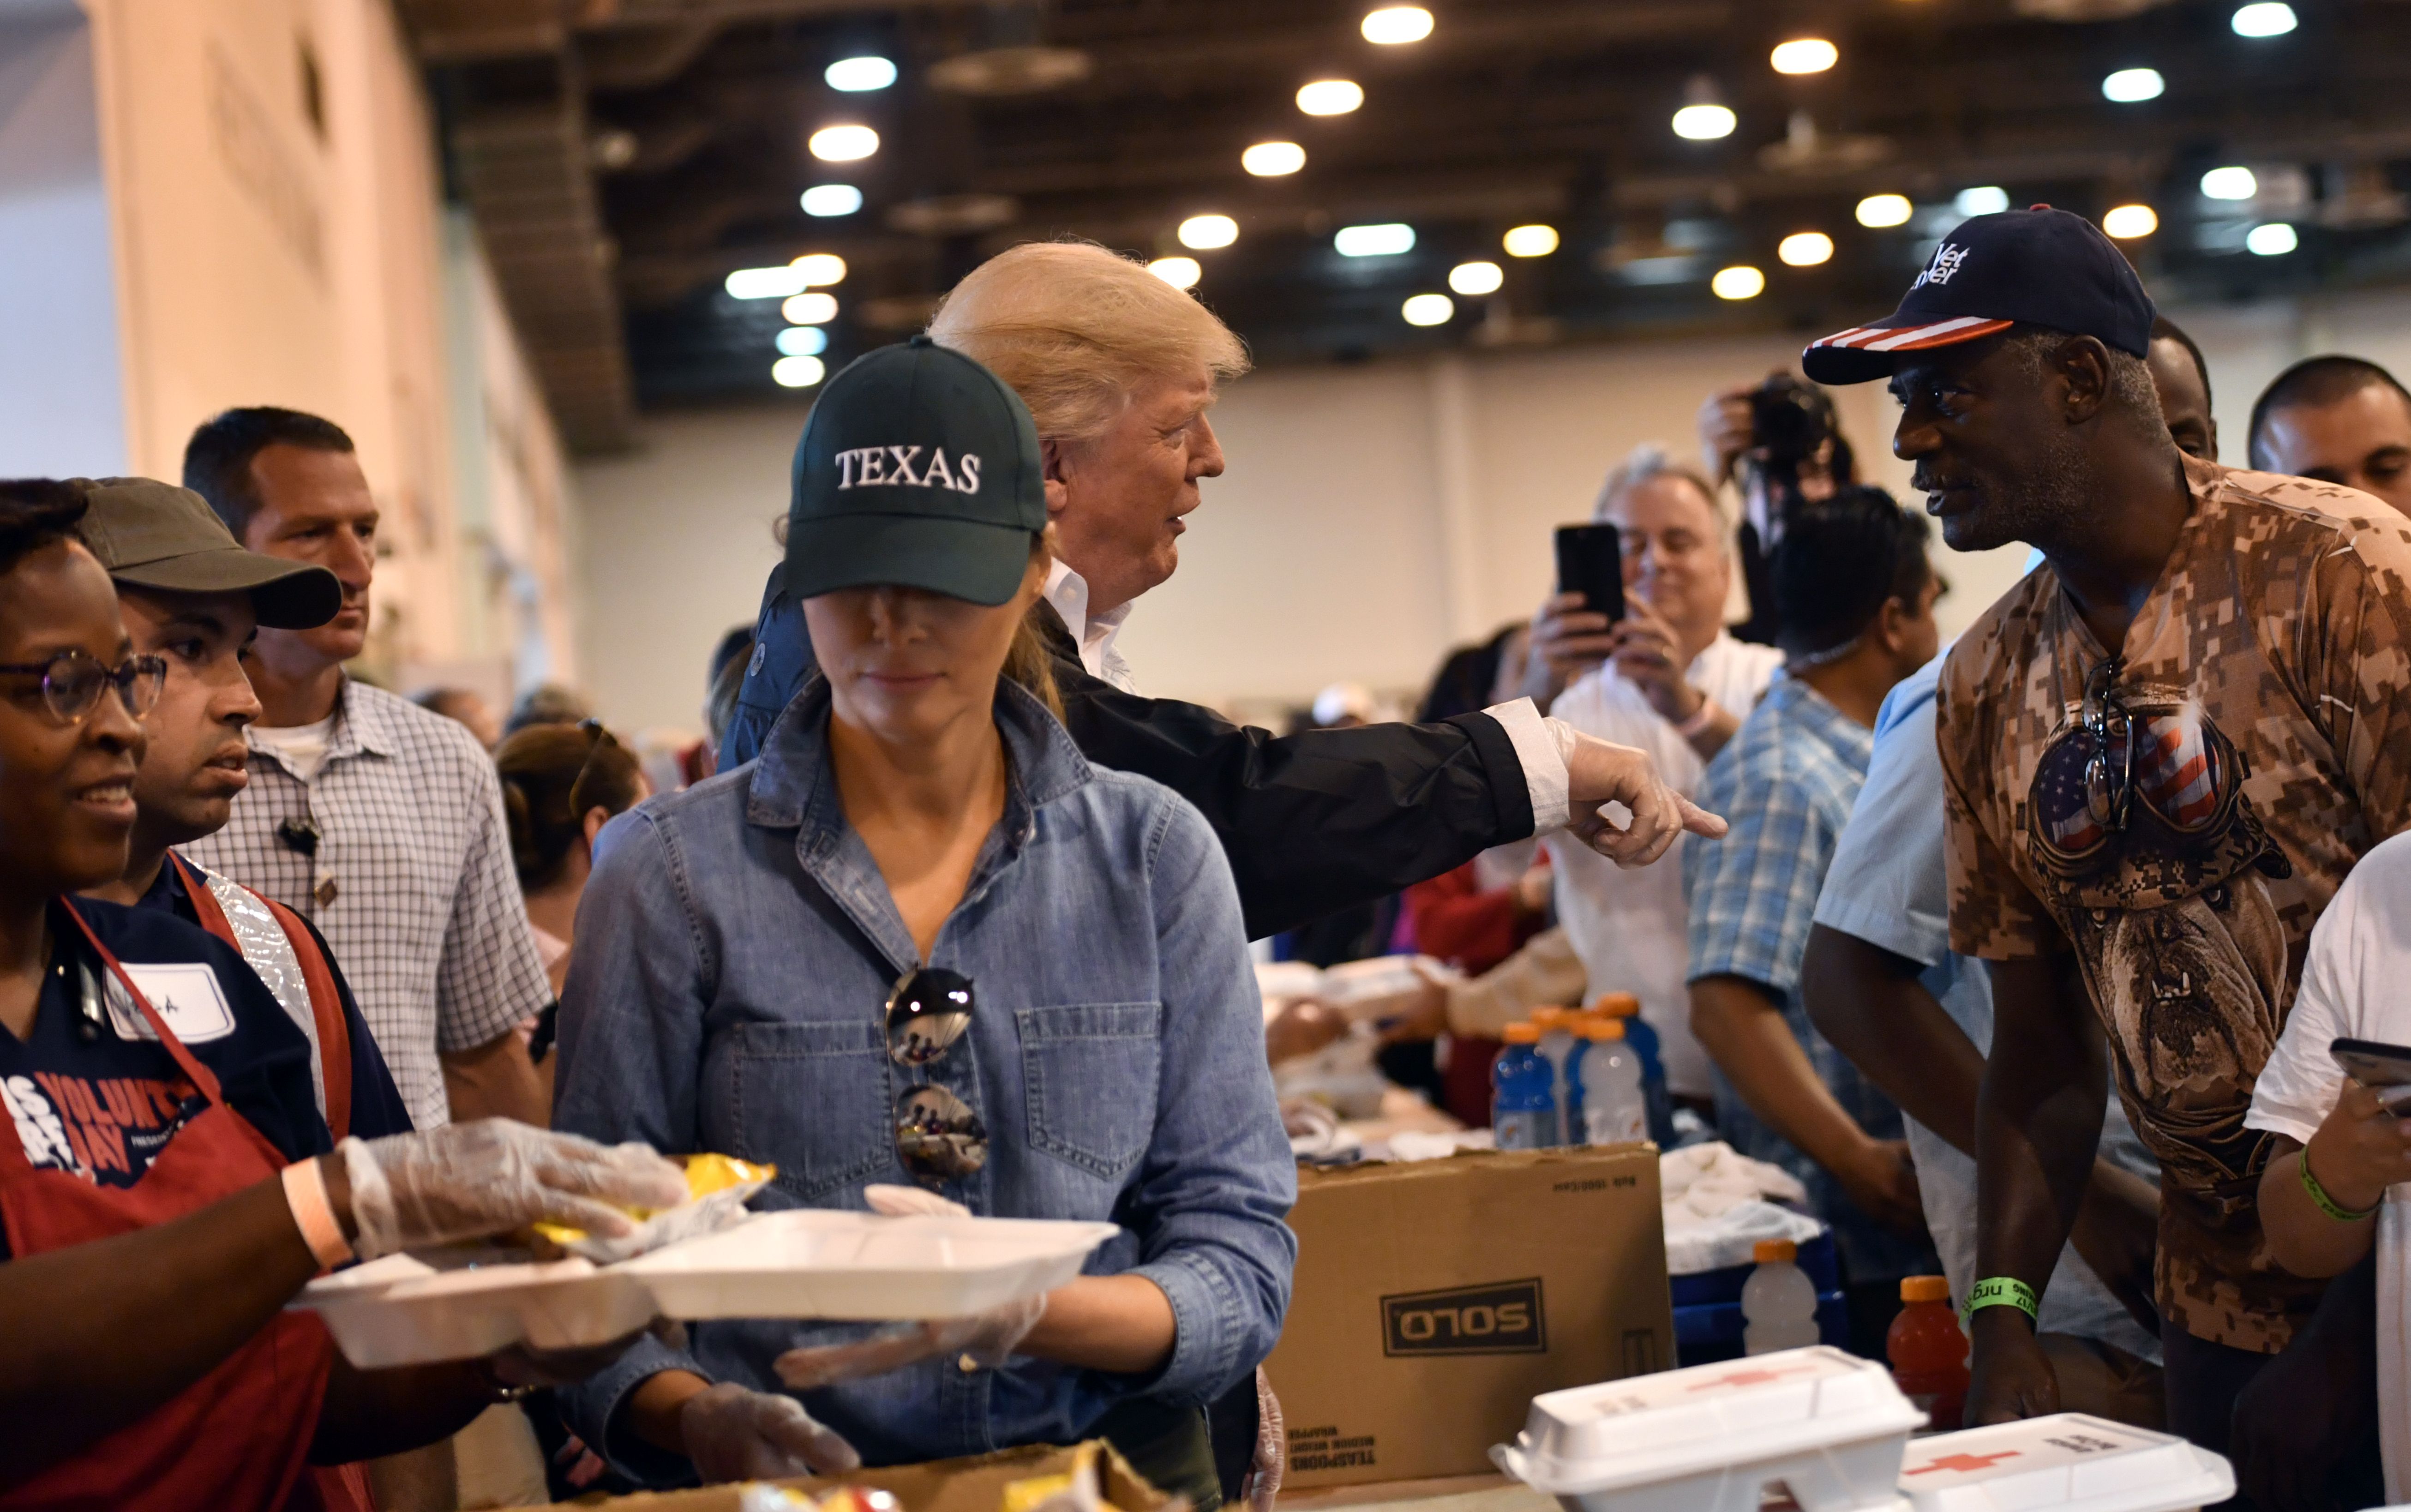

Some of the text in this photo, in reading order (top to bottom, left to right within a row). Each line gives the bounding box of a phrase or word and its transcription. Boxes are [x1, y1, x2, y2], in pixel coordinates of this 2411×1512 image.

[1932, 243, 1970, 268] Vet
[835, 444, 982, 495] TEXAS
[65, 1117, 132, 1175] DAY
[1973, 1284, 2002, 1301] nrg
[1400, 1302, 1530, 1341] SOLO
